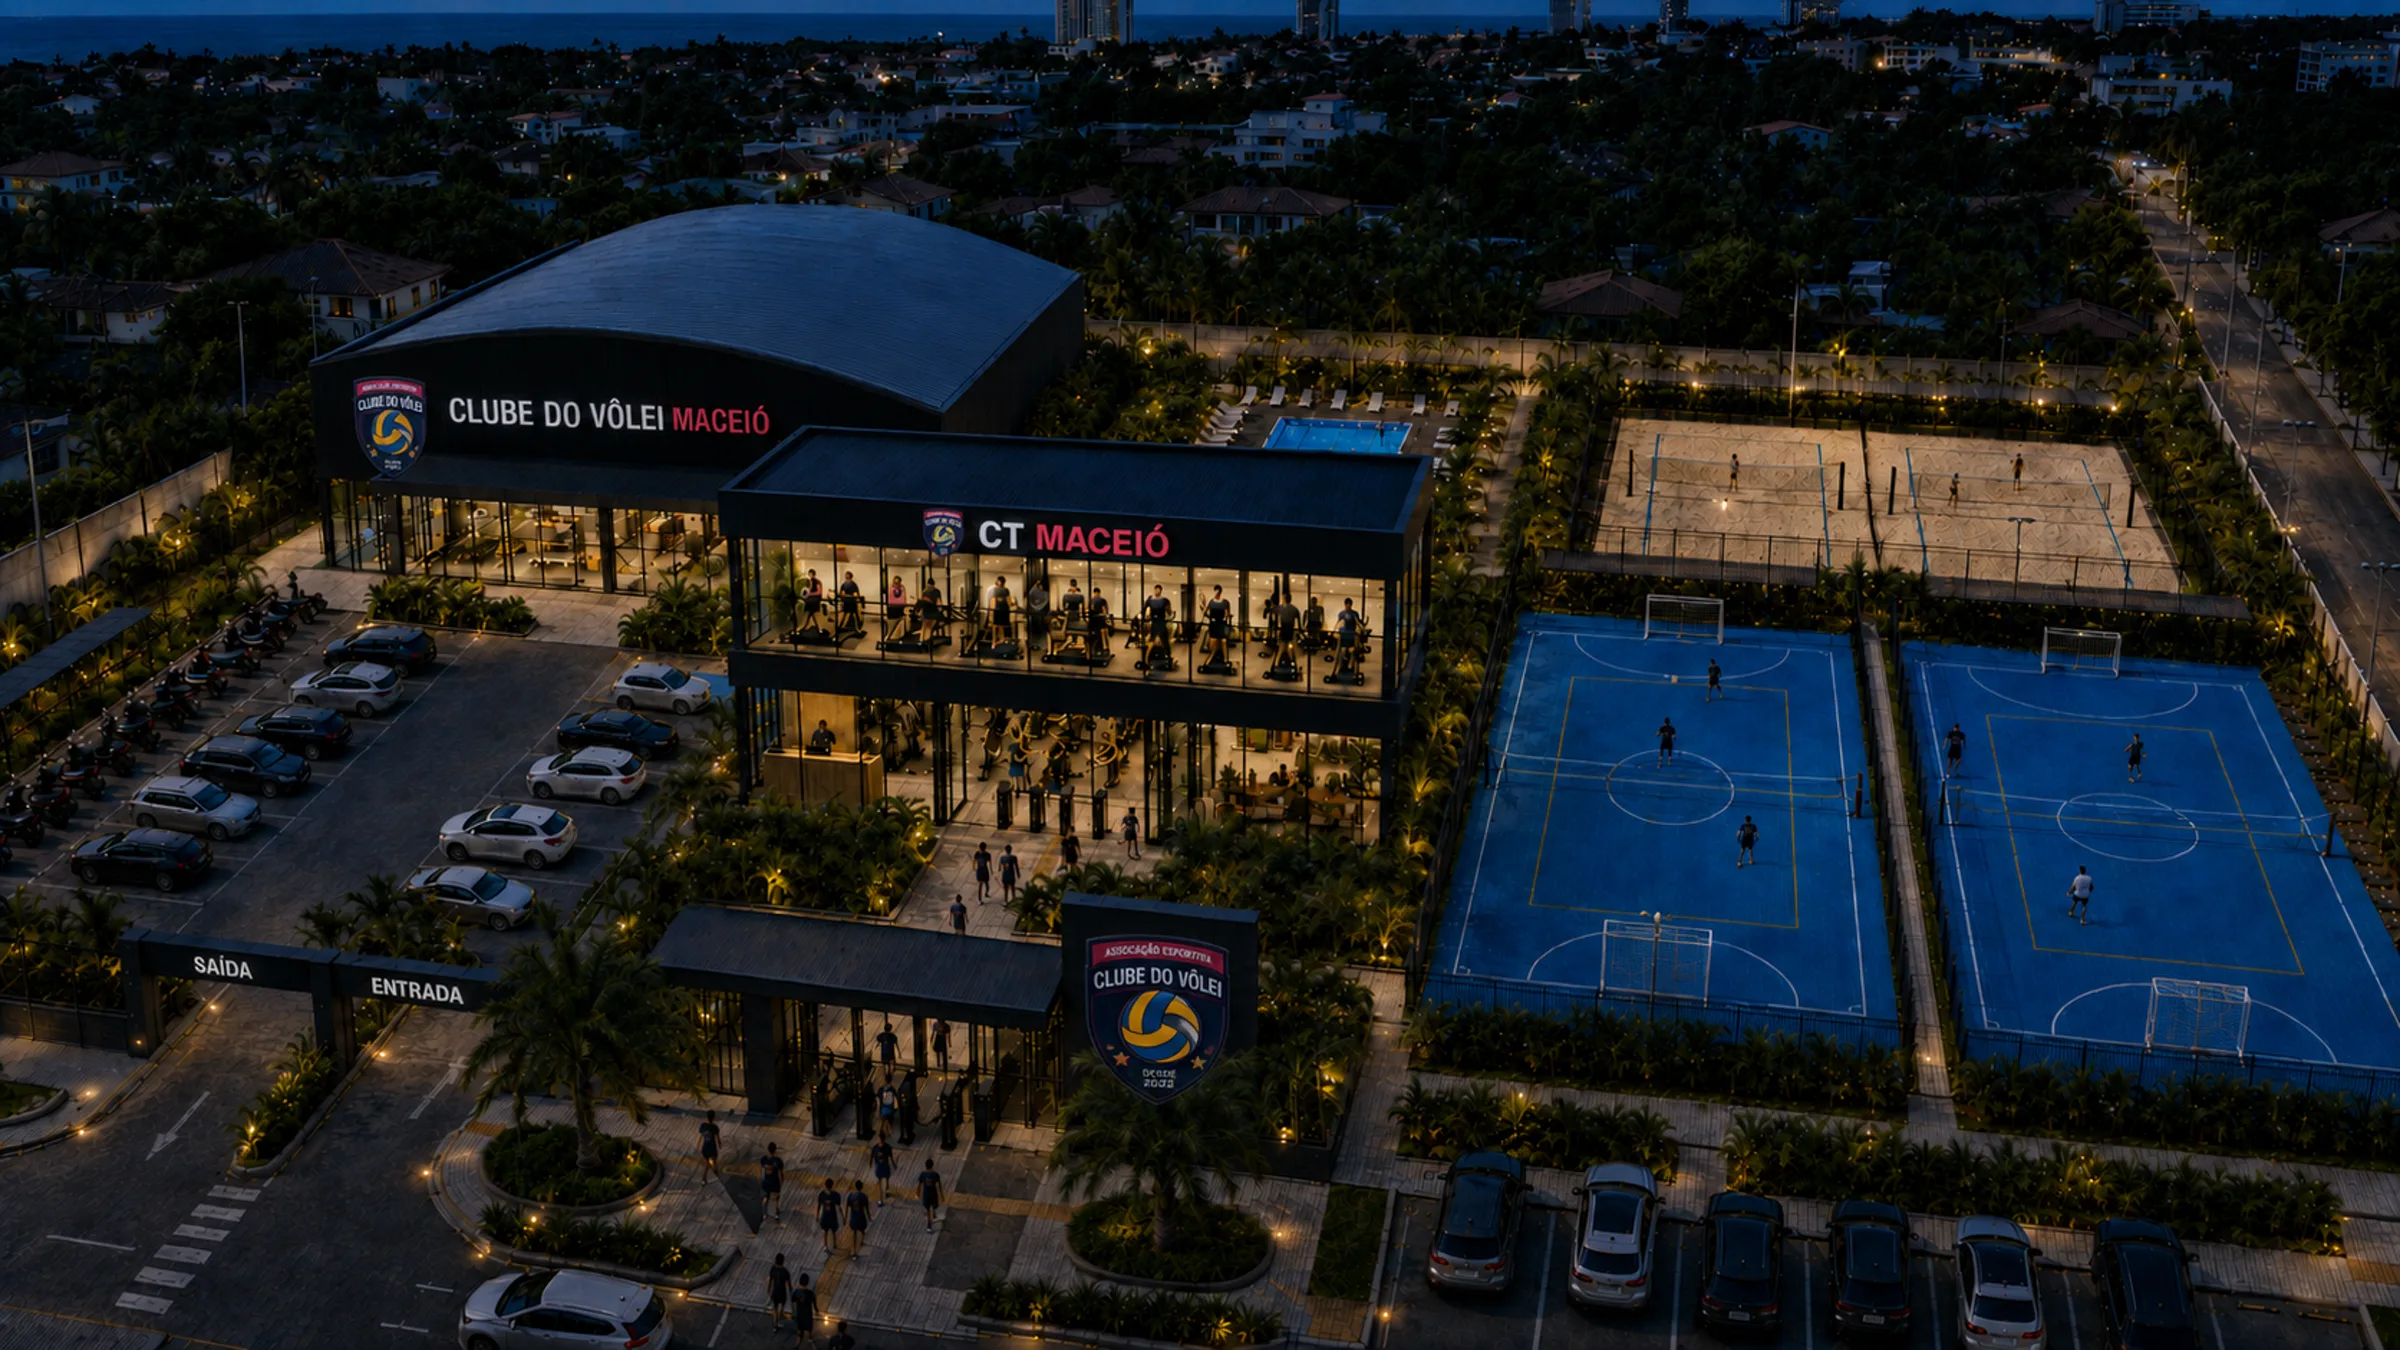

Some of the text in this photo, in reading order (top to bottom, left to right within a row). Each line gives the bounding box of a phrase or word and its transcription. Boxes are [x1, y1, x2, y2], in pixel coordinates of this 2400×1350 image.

[449, 397, 770, 435] CLUBE DO VÔLEI MACEIÓ
[978, 520, 1170, 558] CT MACEIÓ
[193, 954, 253, 980] SAÍDA
[1093, 966, 1222, 999] CLUBE DO VÔLEI
[371, 977, 464, 1005] ENTRADA
